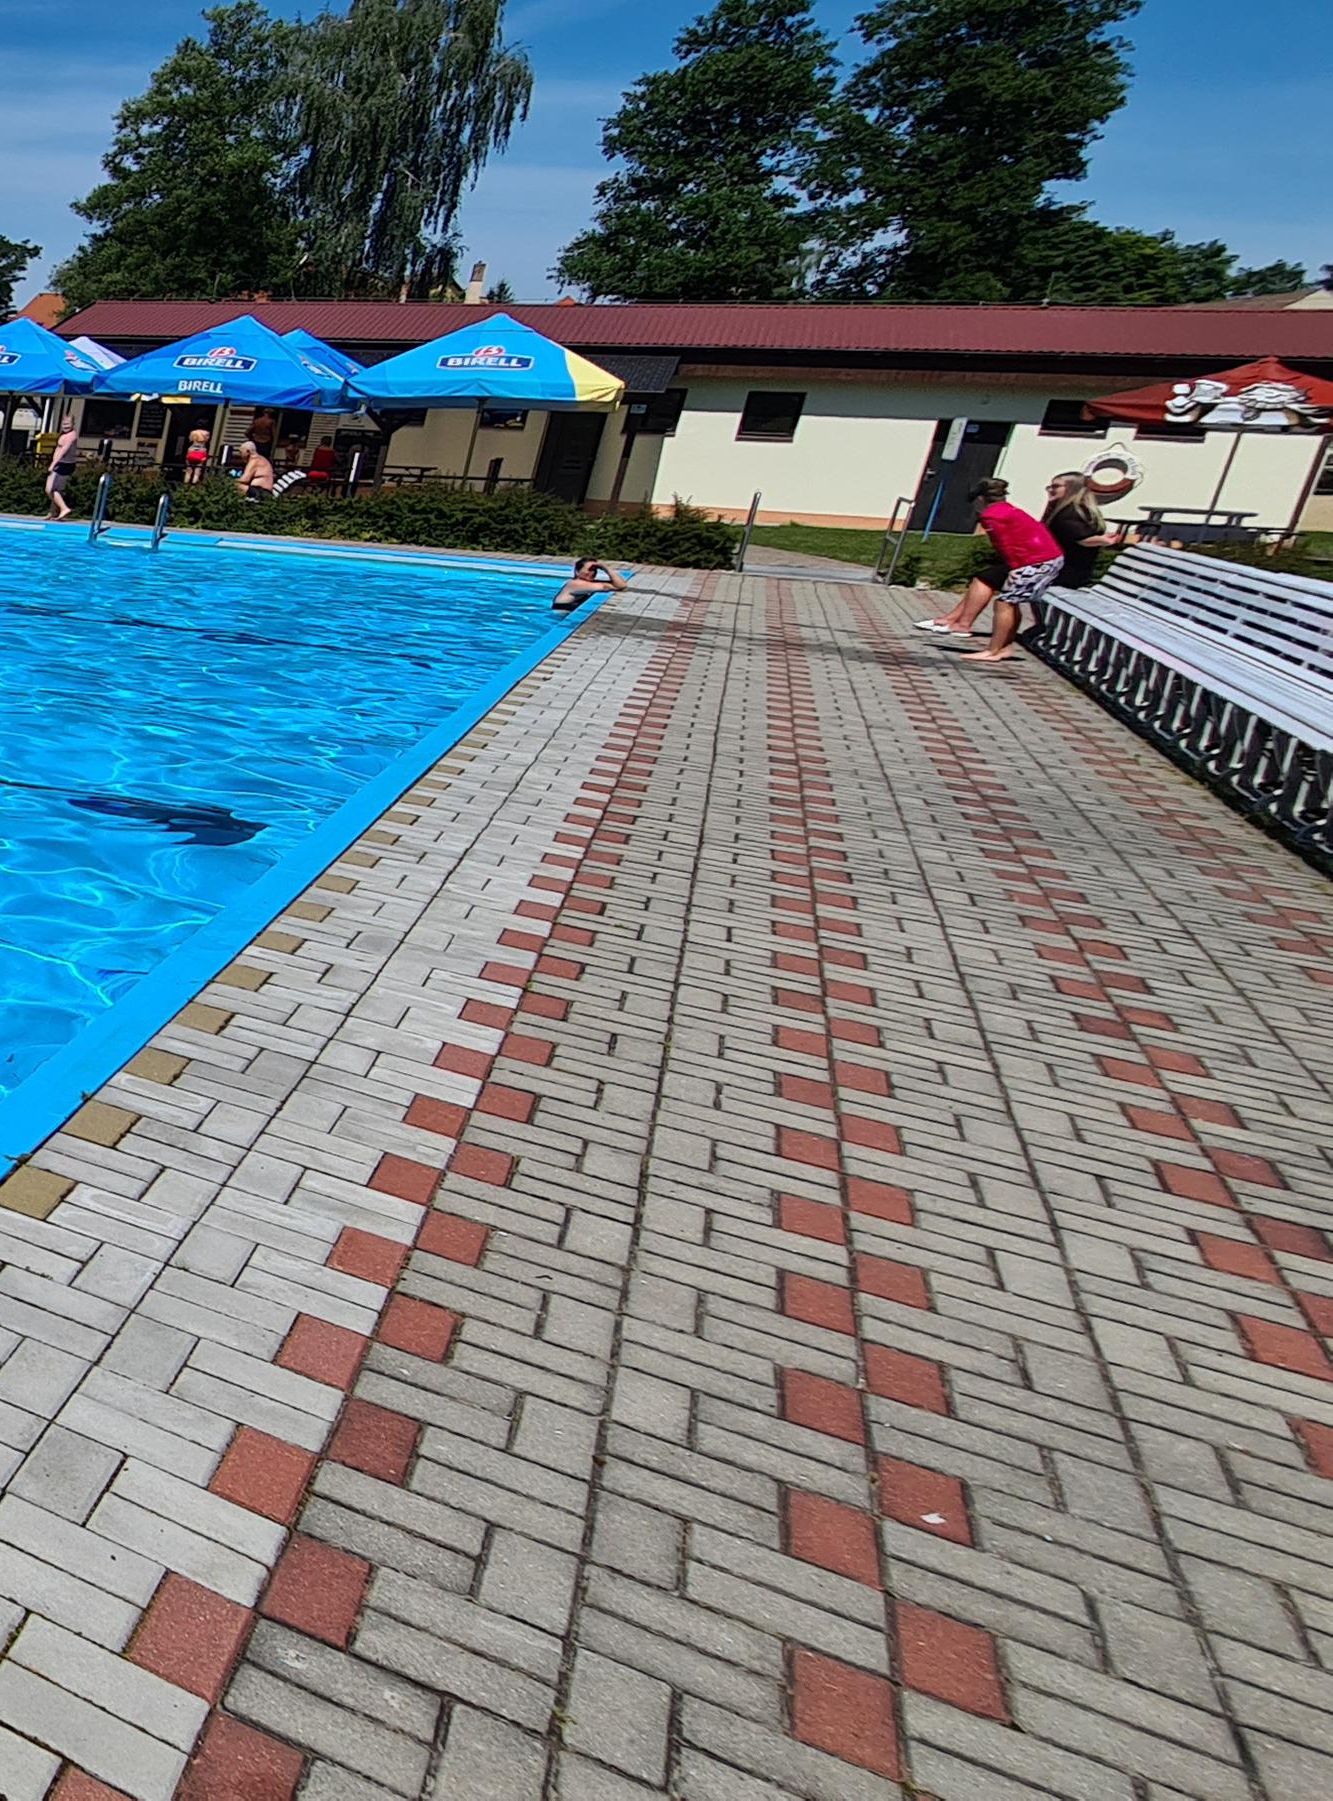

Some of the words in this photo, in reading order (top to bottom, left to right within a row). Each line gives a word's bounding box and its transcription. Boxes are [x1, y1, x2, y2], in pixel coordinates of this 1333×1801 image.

[182, 357, 244, 369] BIRELL
[446, 357, 522, 367] BIRELL
[177, 380, 223, 394] BIRELL
